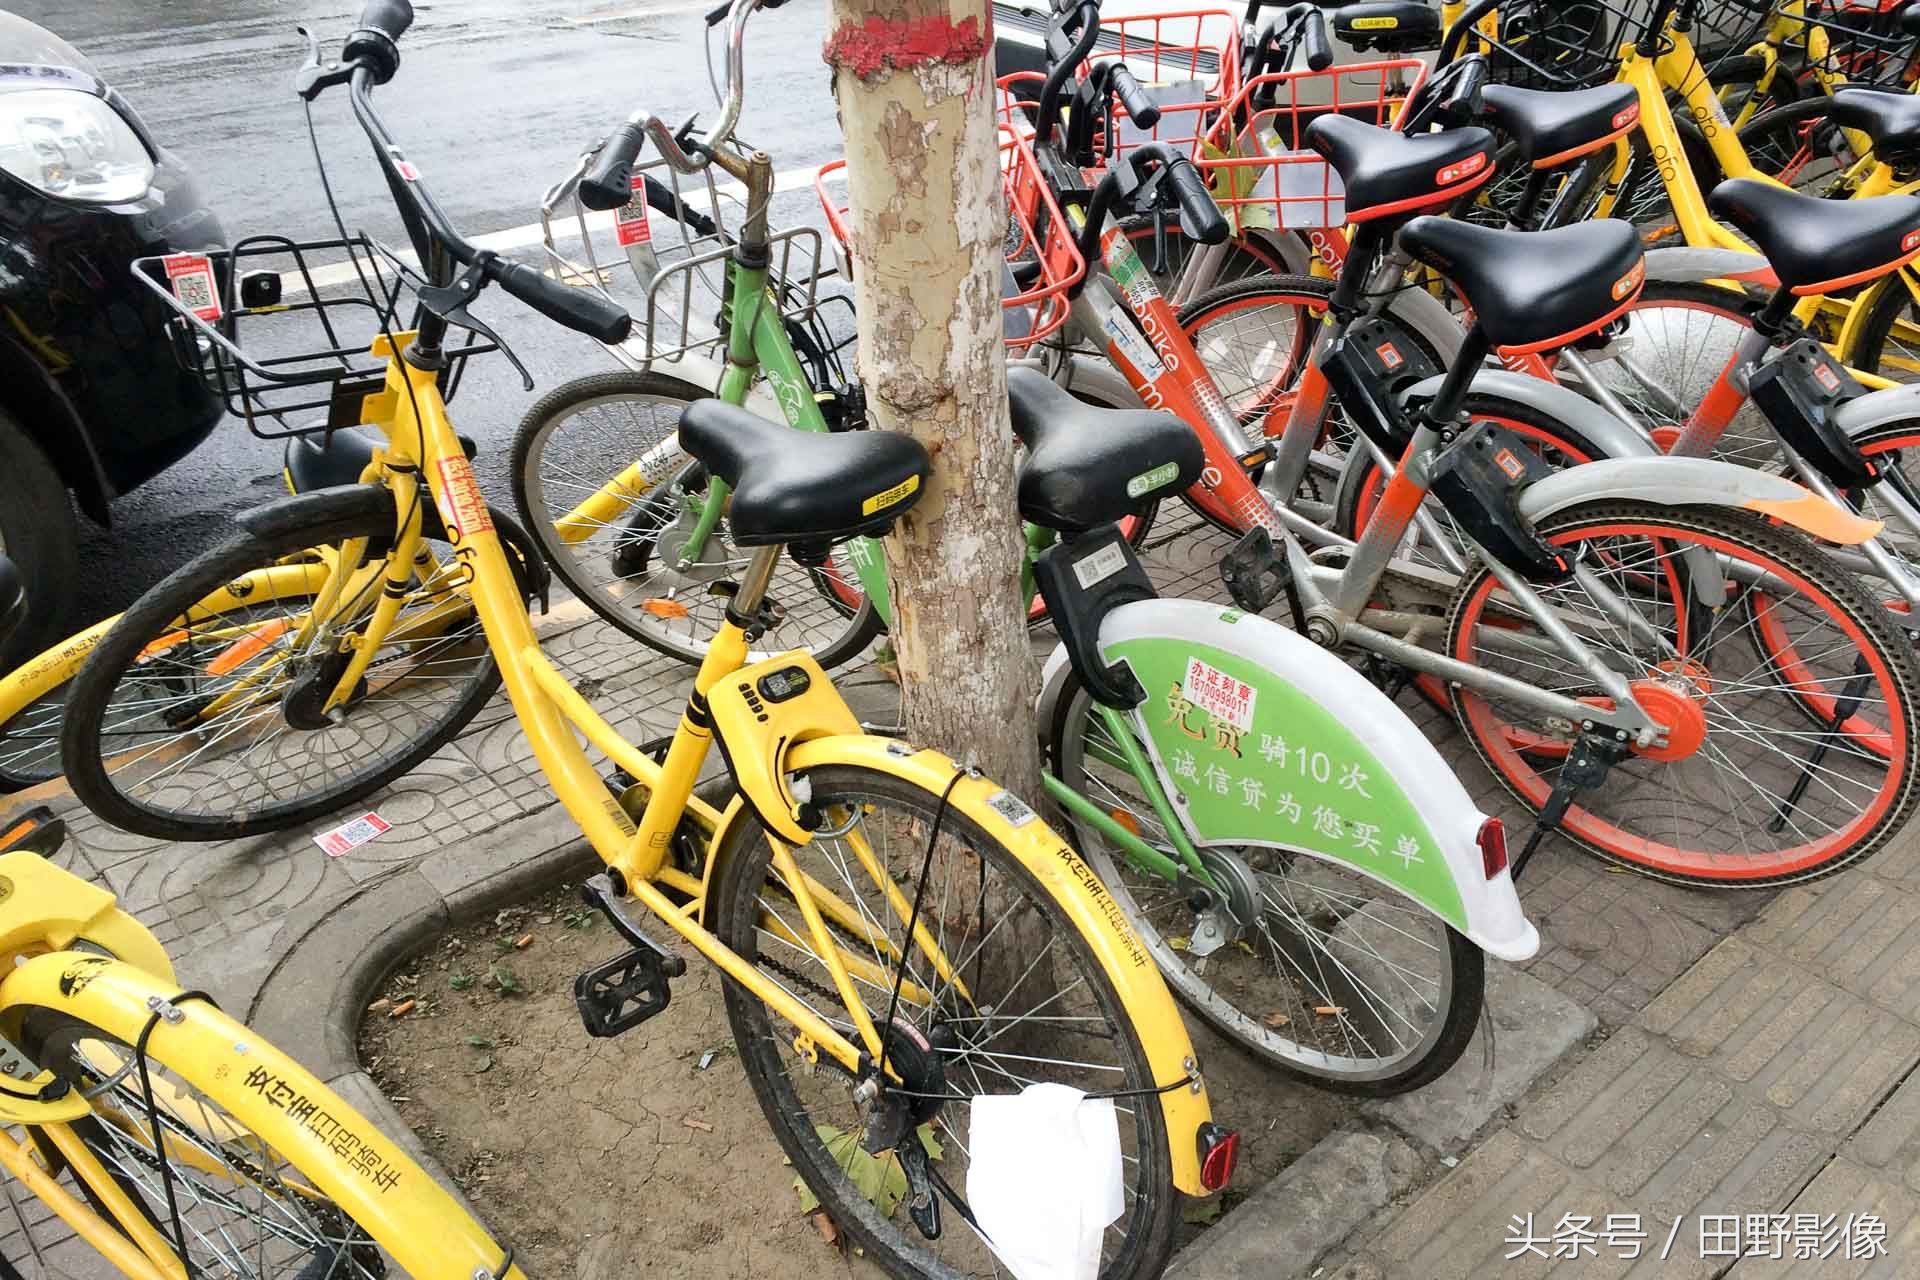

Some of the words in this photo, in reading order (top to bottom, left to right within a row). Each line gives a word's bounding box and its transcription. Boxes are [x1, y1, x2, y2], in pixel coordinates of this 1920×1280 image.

[1694, 106, 1717, 137] ofo
[1654, 144, 1679, 181] ofo
[1191, 661, 1251, 700] 办证刻章
[1171, 747, 1425, 869] 诚信贷为您买单
[243, 1065, 403, 1193] 支付宝扫码骑车
